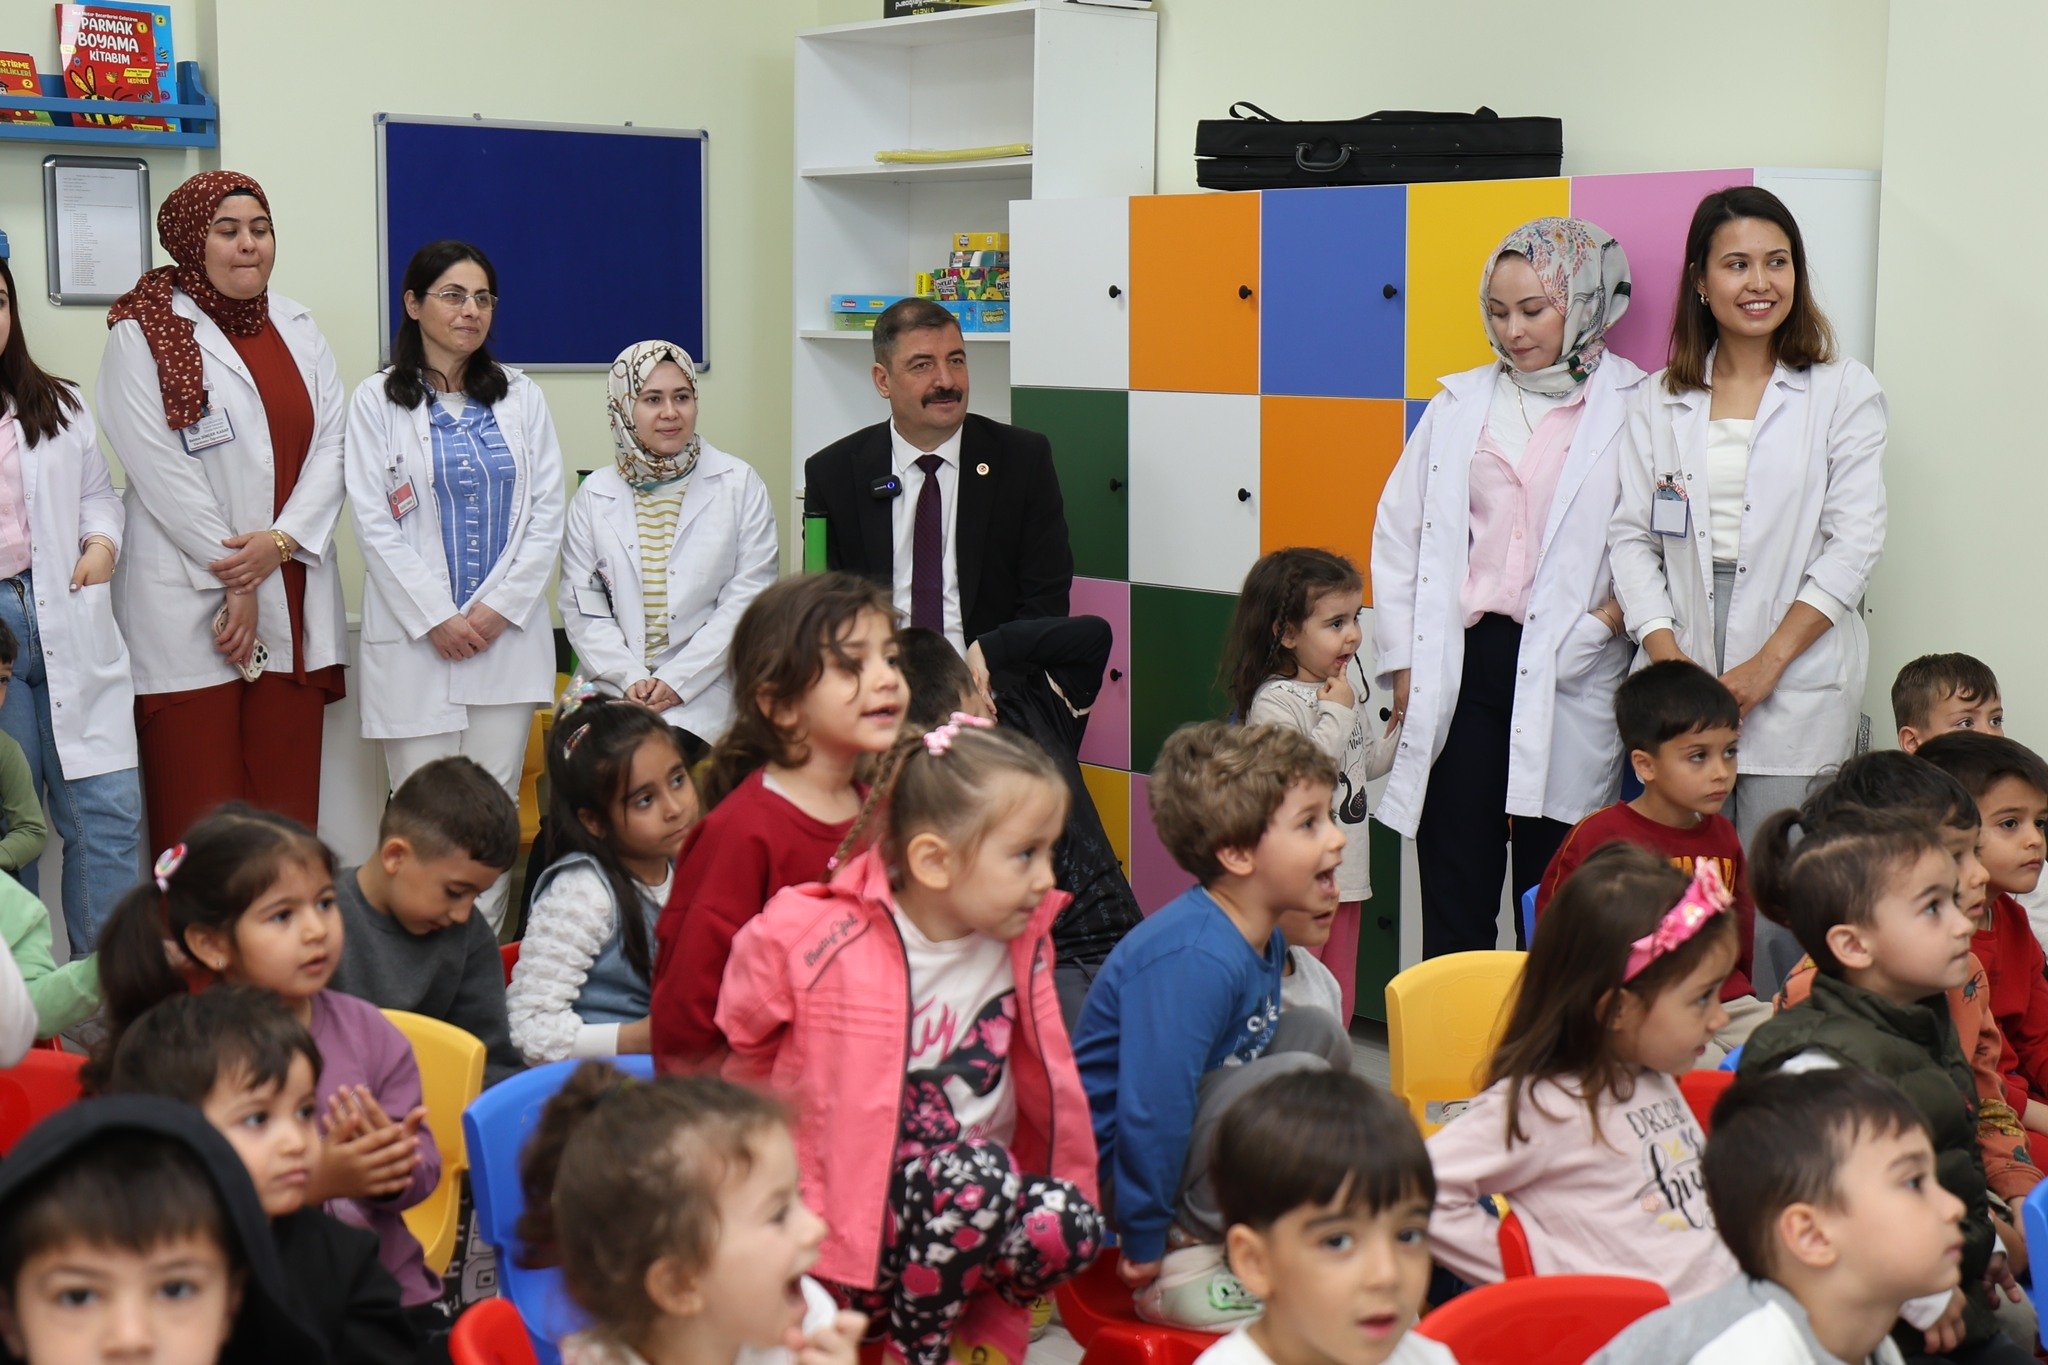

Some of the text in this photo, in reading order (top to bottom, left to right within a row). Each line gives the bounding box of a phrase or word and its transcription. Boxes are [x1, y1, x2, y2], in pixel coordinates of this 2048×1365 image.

[80, 17, 133, 36] PARMAK
[77, 32, 139, 53] BOYAMA
[89, 49, 130, 65] KİTABIM
